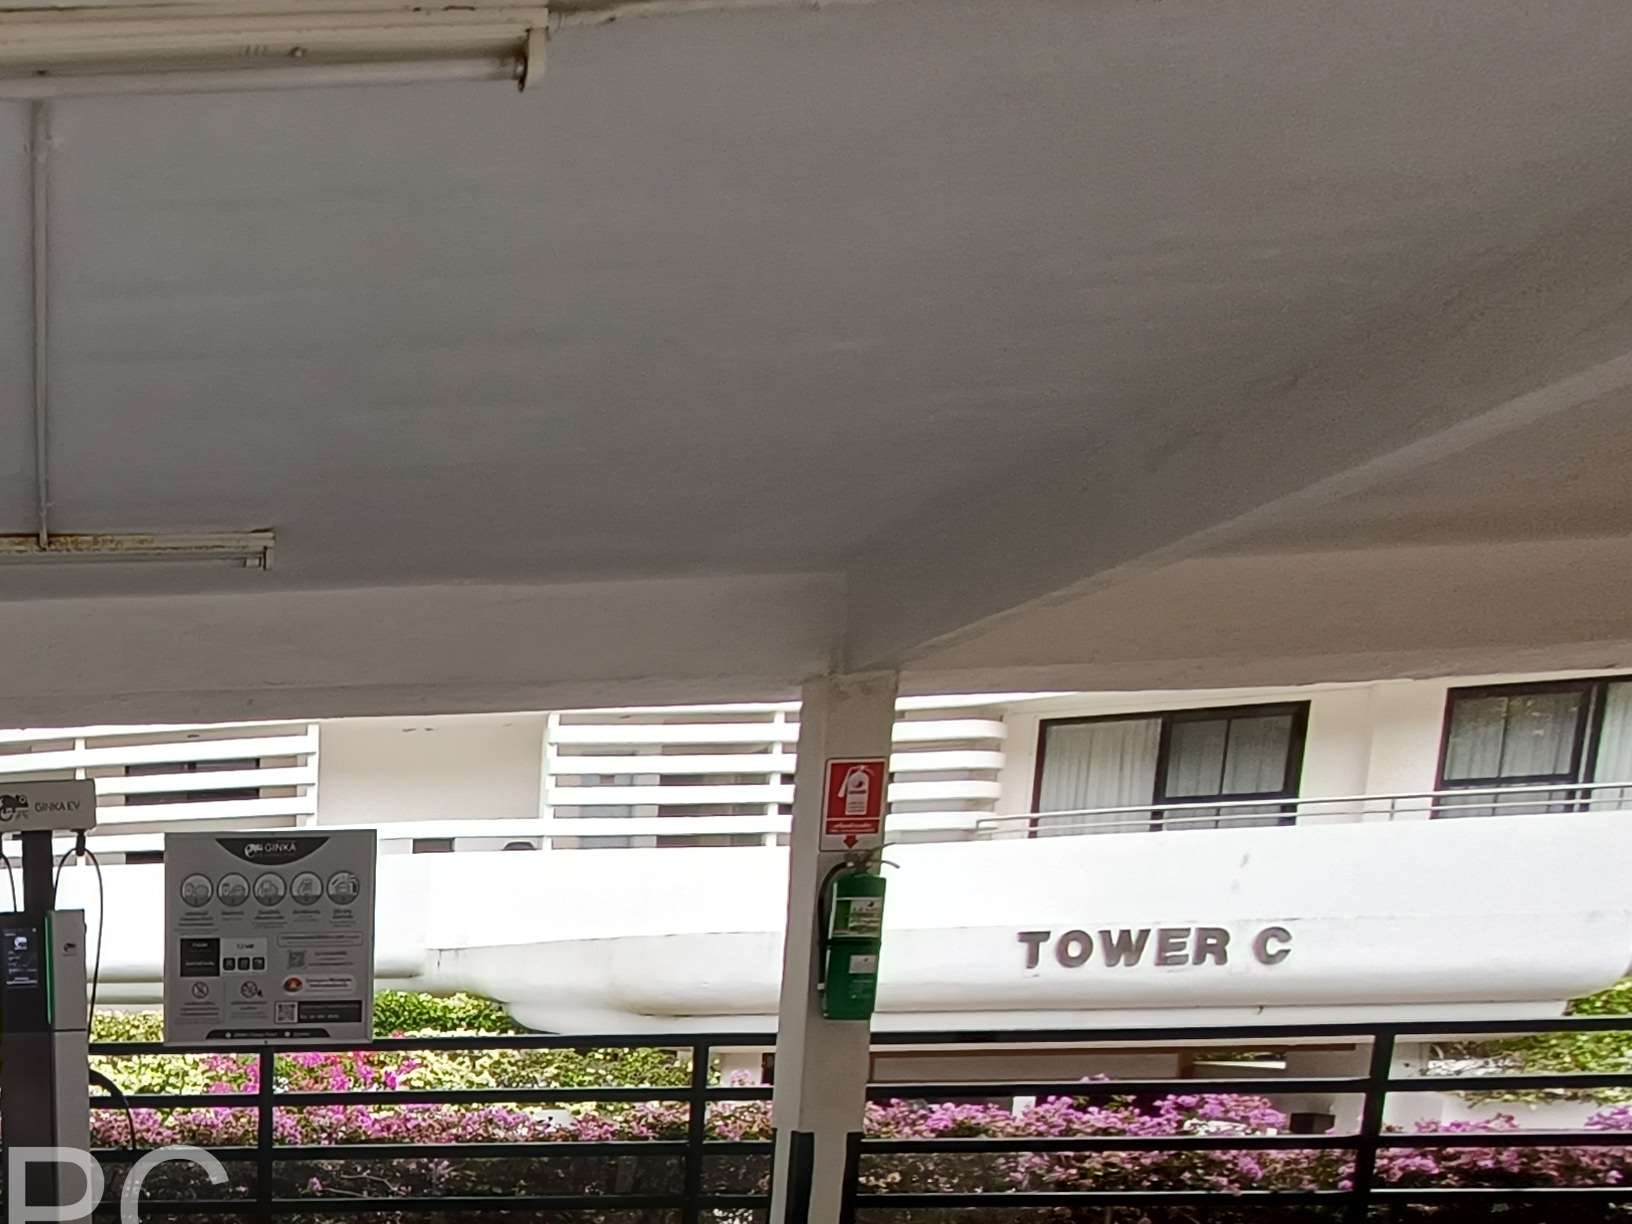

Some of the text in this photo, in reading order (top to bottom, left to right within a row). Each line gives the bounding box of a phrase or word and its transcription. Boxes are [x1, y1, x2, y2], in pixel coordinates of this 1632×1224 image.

[264, 842, 296, 853] GINKA
[1017, 926, 1293, 969] TOWER C
